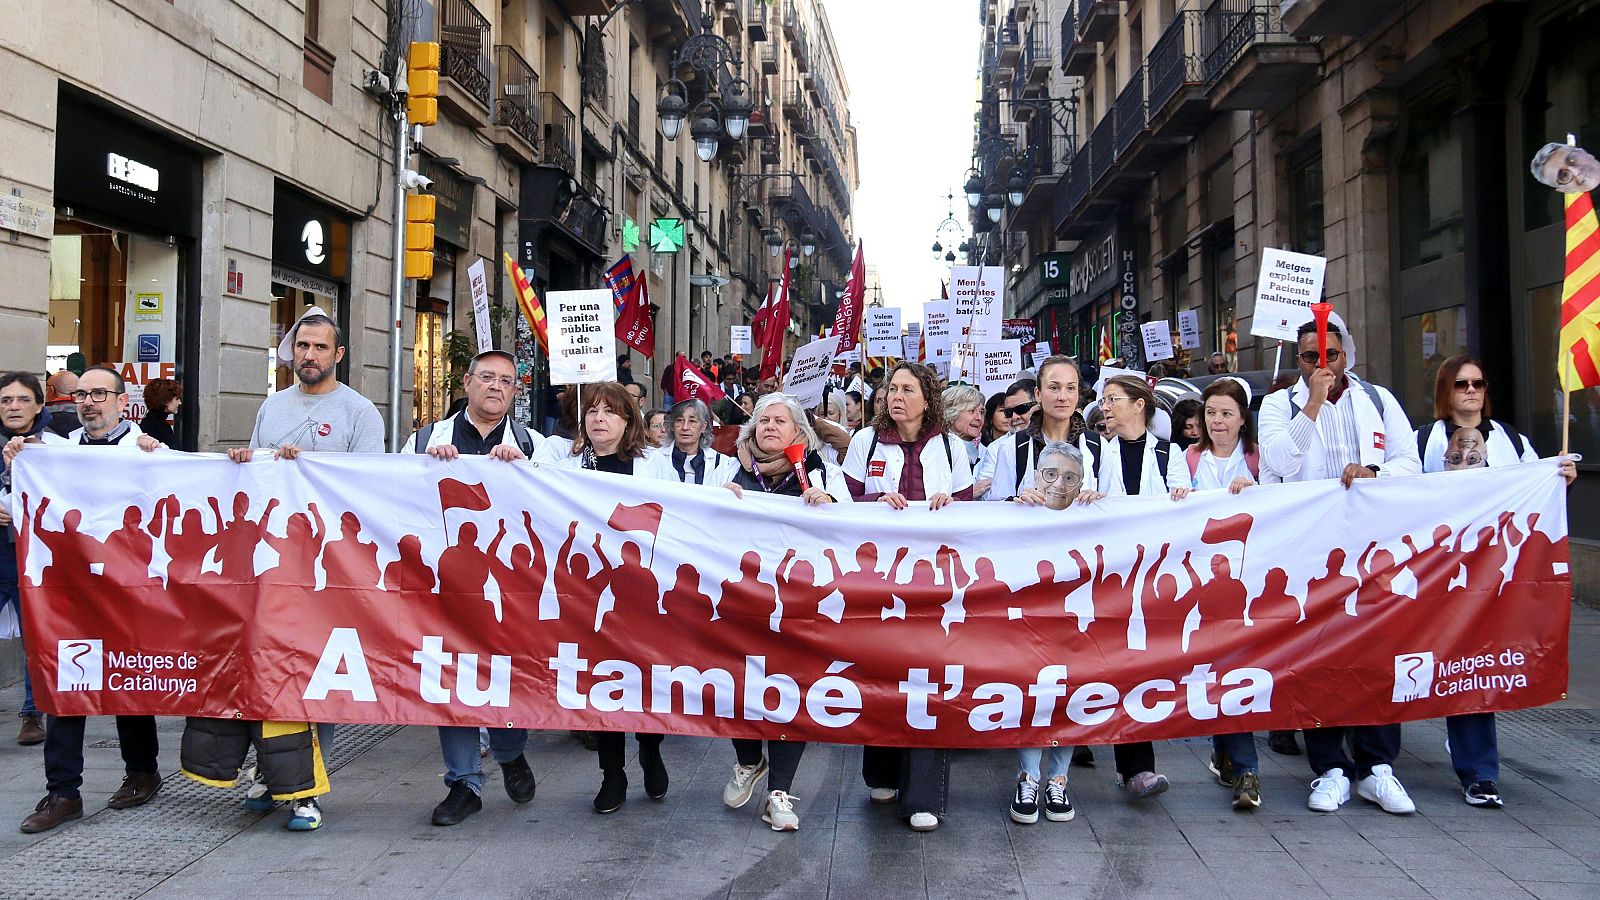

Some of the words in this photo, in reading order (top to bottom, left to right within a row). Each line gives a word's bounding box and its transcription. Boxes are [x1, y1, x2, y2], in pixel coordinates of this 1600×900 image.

[1043, 261, 1059, 279] 15
[1275, 259, 1311, 273] Metges
[957, 279, 986, 287] Mens
[1269, 272, 1314, 286] explotats
[1046, 287, 1068, 300] elati
[1269, 281, 1311, 296] Pacients
[559, 303, 577, 312] Per
[579, 302, 600, 311] una
[842, 286, 853, 331] Metges
[561, 313, 599, 322] sanitat
[560, 324, 602, 336] pública
[570, 335, 575, 344] i
[576, 335, 590, 344] de
[844, 333, 851, 348] de
[560, 345, 603, 358] qualitat
[984, 351, 1013, 359] SANITAT,
[794, 362, 819, 374] espera
[797, 357, 816, 366] Tanta
[984, 359, 1013, 367] PÚBLICA
[101, 362, 176, 385] ALE
[789, 371, 826, 387] desespera
[792, 372, 806, 381] ens
[985, 373, 1017, 382] QUALITAT
[108, 651, 174, 671] Metges
[177, 654, 197, 670] de
[1438, 653, 1495, 678] Metges
[1499, 649, 1525, 666] de
[108, 673, 197, 696] Catalunya
[301, 627, 377, 702] A
[412, 635, 512, 708] tu
[548, 642, 863, 728] també
[898, 663, 1274, 732] t'afecta
[1435, 673, 1527, 697] Catalunya
